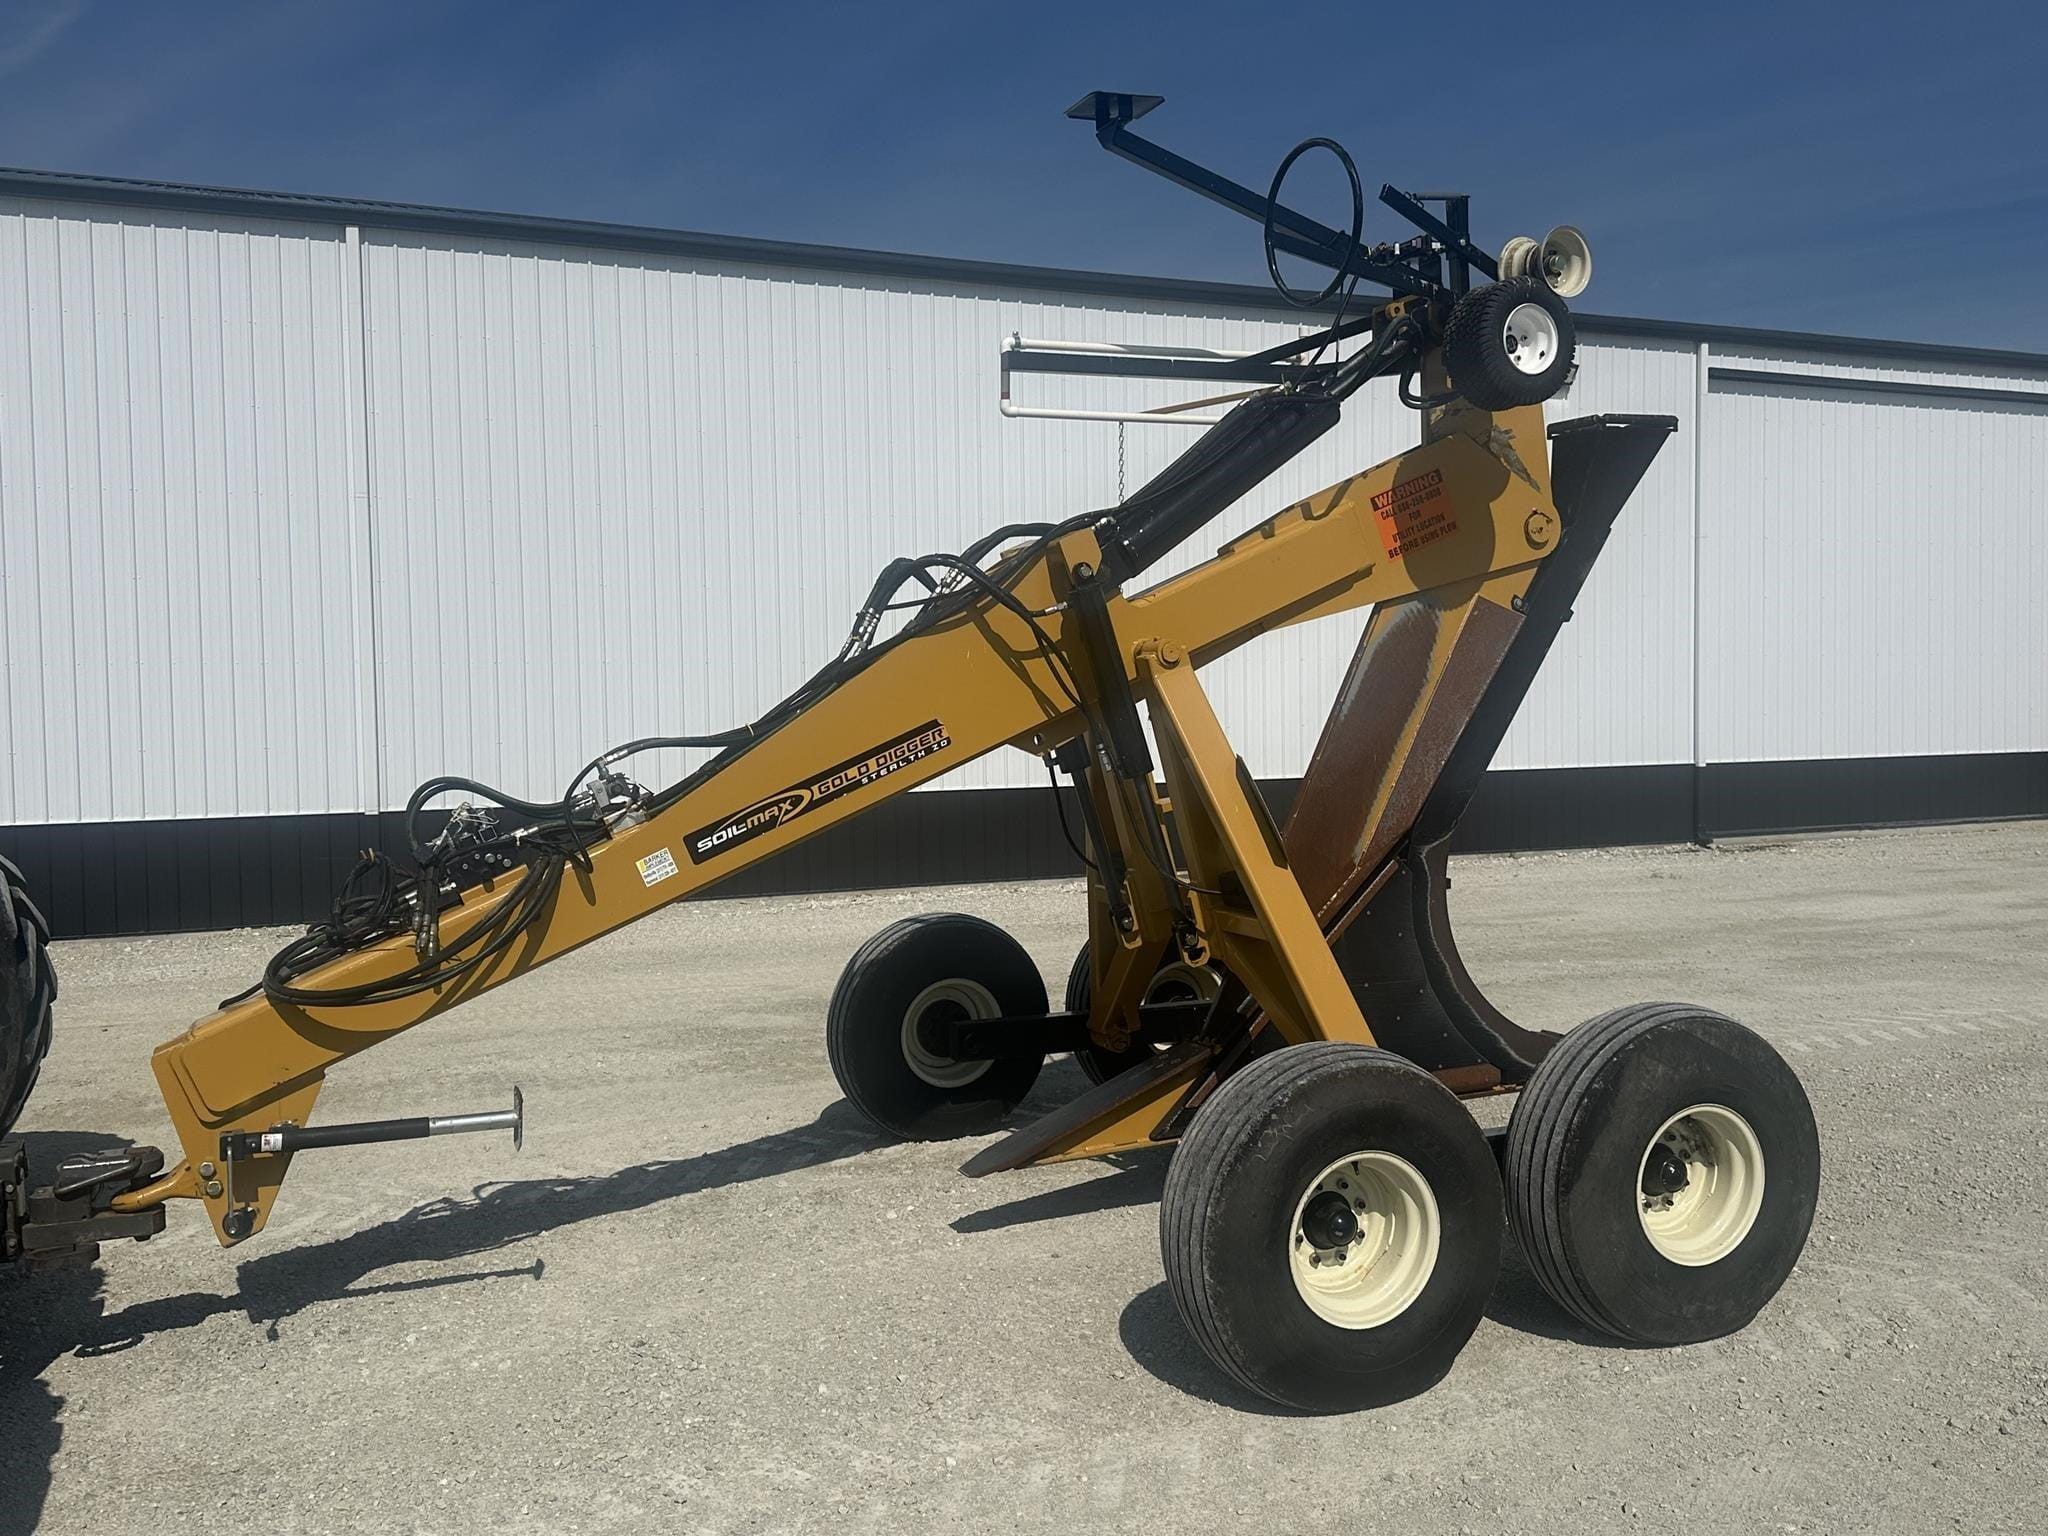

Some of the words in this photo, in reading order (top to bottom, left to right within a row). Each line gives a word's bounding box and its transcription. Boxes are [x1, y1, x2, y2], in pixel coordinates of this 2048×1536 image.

[1374, 472, 1439, 508] WARNING
[1381, 505, 1397, 520] CALL
[1392, 526, 1415, 543] UTILITY
[1417, 512, 1446, 532] LOCATION
[1408, 510, 1421, 521] FOR
[1388, 538, 1419, 559] BEFORE
[1420, 530, 1439, 544] USING
[818, 762, 869, 795] GOLD
[876, 728, 944, 768] DIGGER
[861, 750, 926, 785] STEALTH
[643, 849, 669, 866] BARKER
